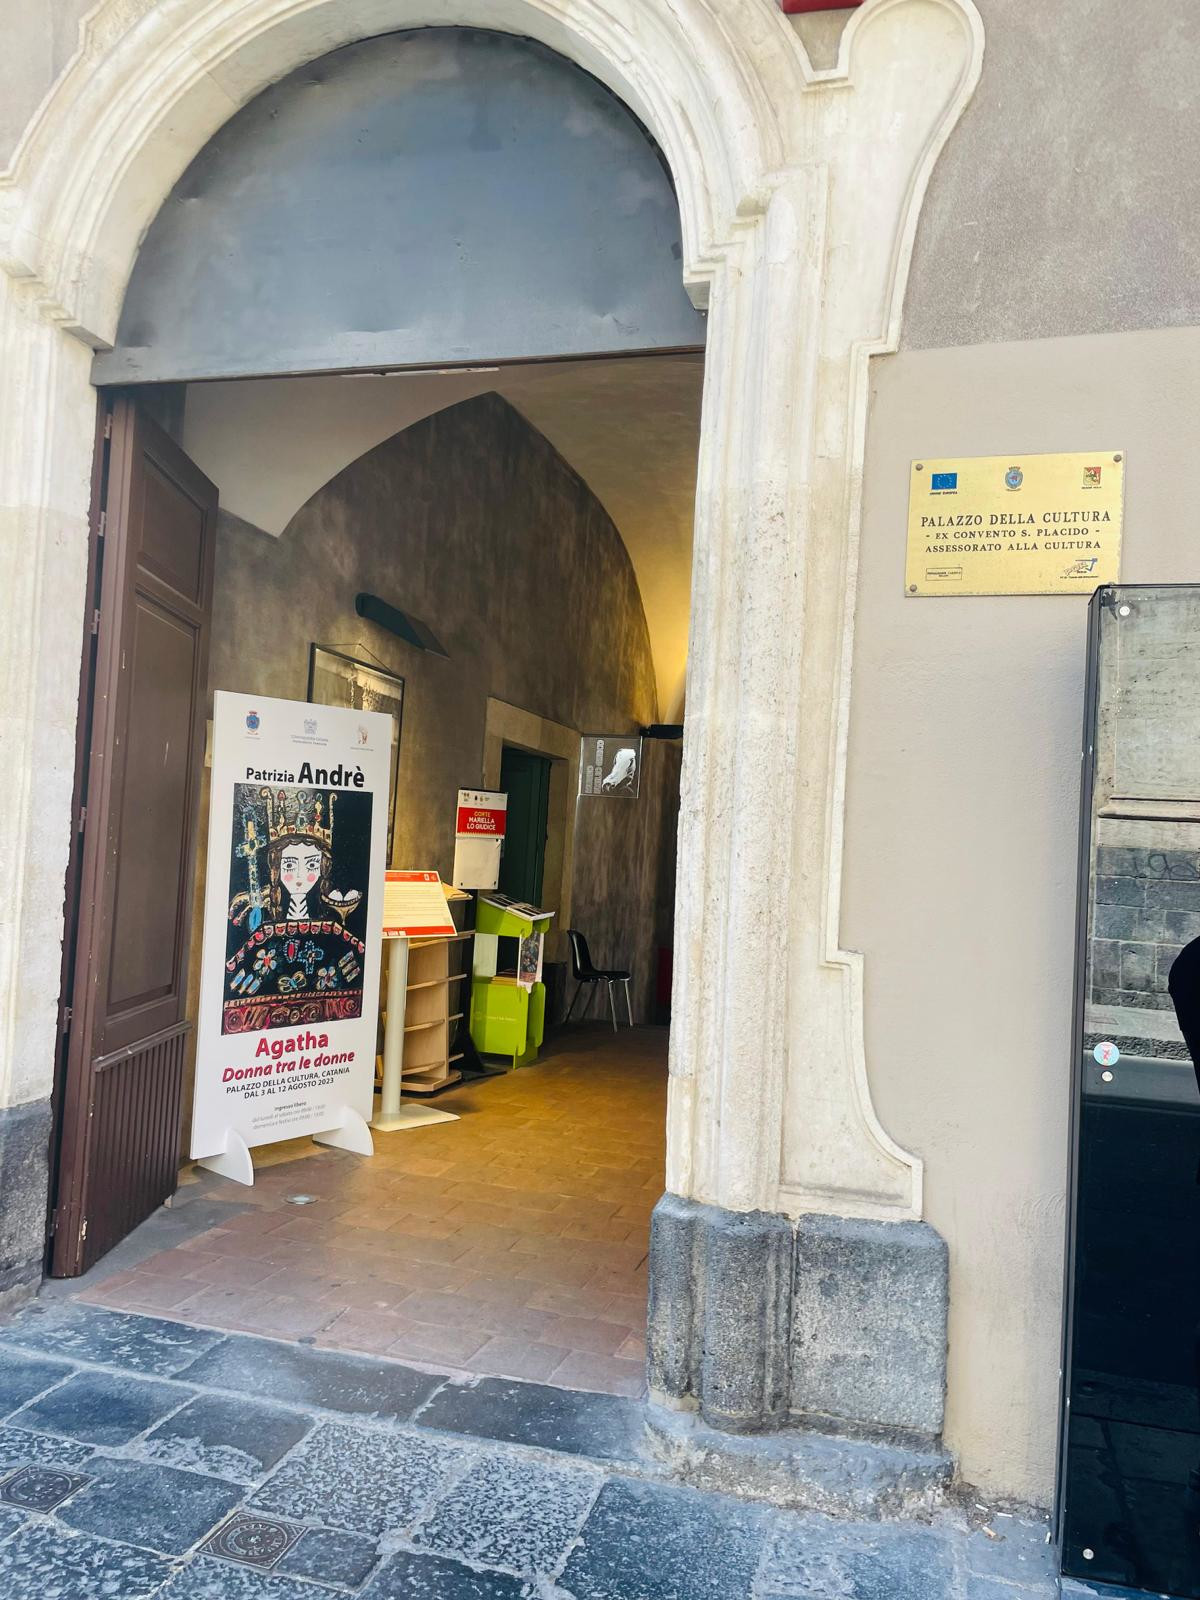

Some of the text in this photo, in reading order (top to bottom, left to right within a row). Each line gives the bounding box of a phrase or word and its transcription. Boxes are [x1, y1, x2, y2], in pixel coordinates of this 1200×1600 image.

[921, 510, 1111, 527] PALAZZO DELLA CULTURA
[953, 530, 1016, 539] CONVENTO
[1021, 529, 1031, 537] S.
[1037, 528, 1089, 537] PLACIDO
[925, 541, 1101, 553] ASSESSORATO ALLA CULTURA
[246, 762, 365, 788] Patrizia Andrè
[255, 1031, 329, 1060] Agatha
[222, 1051, 355, 1082] Donna tra le donne
[226, 1066, 350, 1094] PALAZZO DELLA CULTURA, CATANIA
[244, 1077, 334, 1099] DAL 3 AL 12 AGOSTO 2023
